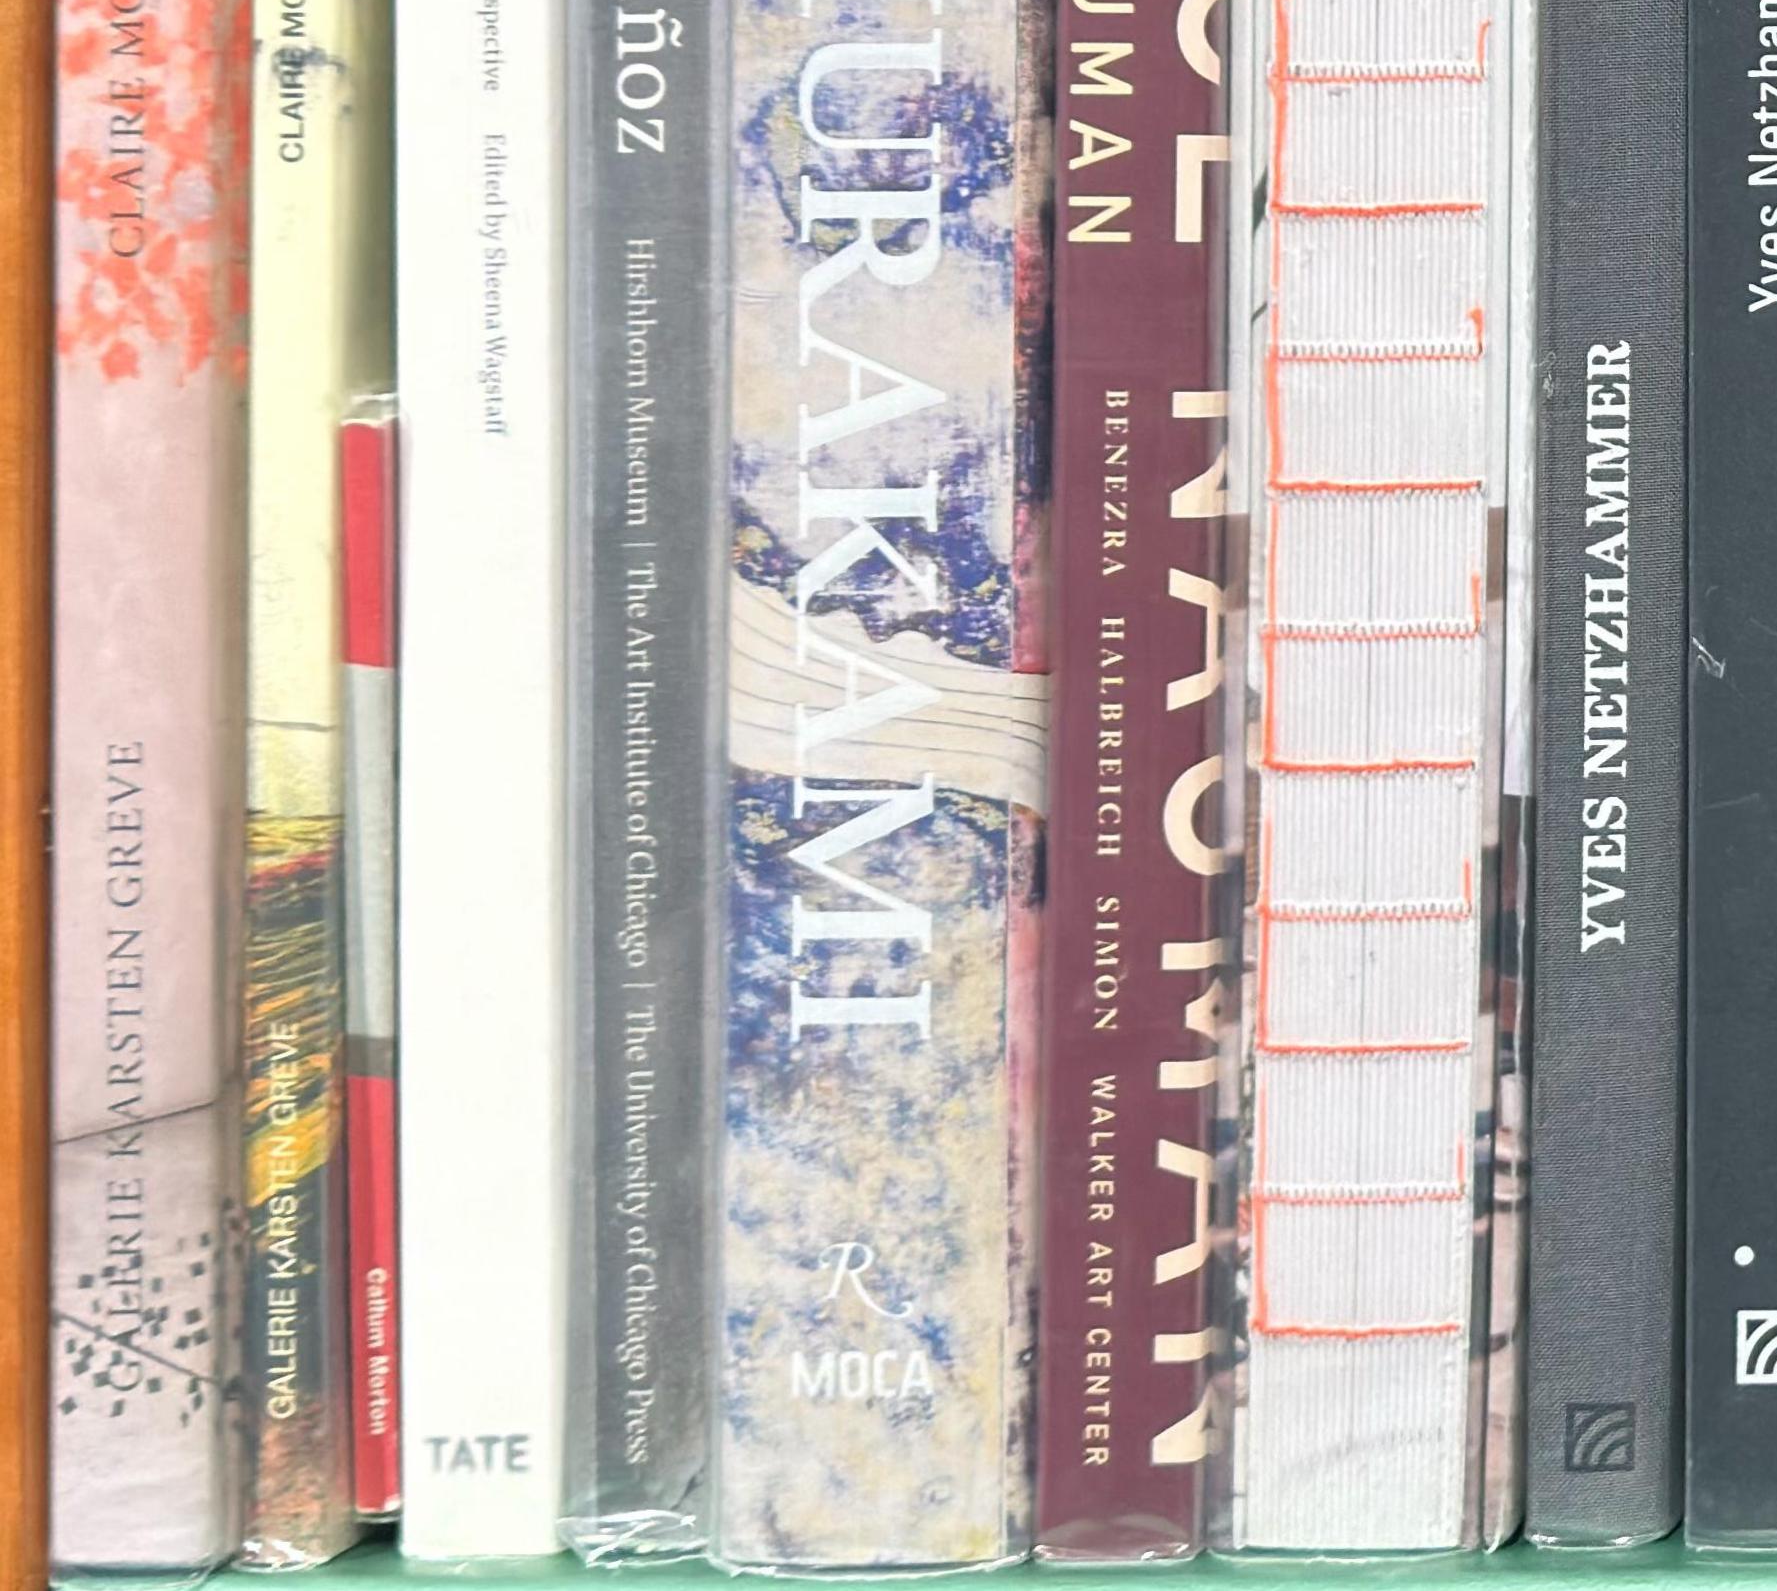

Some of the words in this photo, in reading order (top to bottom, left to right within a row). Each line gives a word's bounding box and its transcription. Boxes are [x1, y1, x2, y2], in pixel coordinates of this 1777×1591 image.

[279, 42, 305, 163] CLAIRE
[107, 77, 146, 259] CLAIRE
[477, 214, 507, 240] by
[484, 135, 507, 205] Edited
[484, 247, 508, 330] Sheena
[626, 238, 655, 385] Hirshhorn
[478, 336, 509, 436] Wagstaff
[626, 396, 655, 527] Museum
[1102, 389, 1130, 577] BENEZRA
[625, 562, 655, 618] The
[1584, 339, 1631, 779] NETZHAMMER
[626, 626, 655, 675] Art
[625, 682, 655, 806] Institute
[1094, 616, 1126, 857] HALBREICH
[107, 741, 144, 907] GREVE
[625, 813, 655, 848] of
[1581, 795, 1627, 954] YVES
[617, 851, 655, 968] Chicago
[1094, 897, 1120, 1031] SIMON
[107, 929, 144, 1156] KARSTEN
[270, 1021, 298, 1127] GREVE
[625, 1009, 655, 1061] The
[617, 1064, 655, 1218] University
[1087, 1075, 1117, 1222] WALKER
[269, 1134, 296, 1281] KARSTEN
[625, 1225, 655, 1256] of
[105, 1177, 144, 1392] GALERIE
[365, 1268, 389, 1350] Callum
[617, 1260, 655, 1384] Chicago
[1085, 1242, 1114, 1308] ART
[268, 1287, 296, 1420] GALERIE
[370, 1355, 389, 1437] Morton
[792, 1349, 934, 1400] MOCA
[1081, 1327, 1112, 1467] CENTER
[425, 1434, 530, 1476] TATE
[626, 1391, 655, 1466] Press
